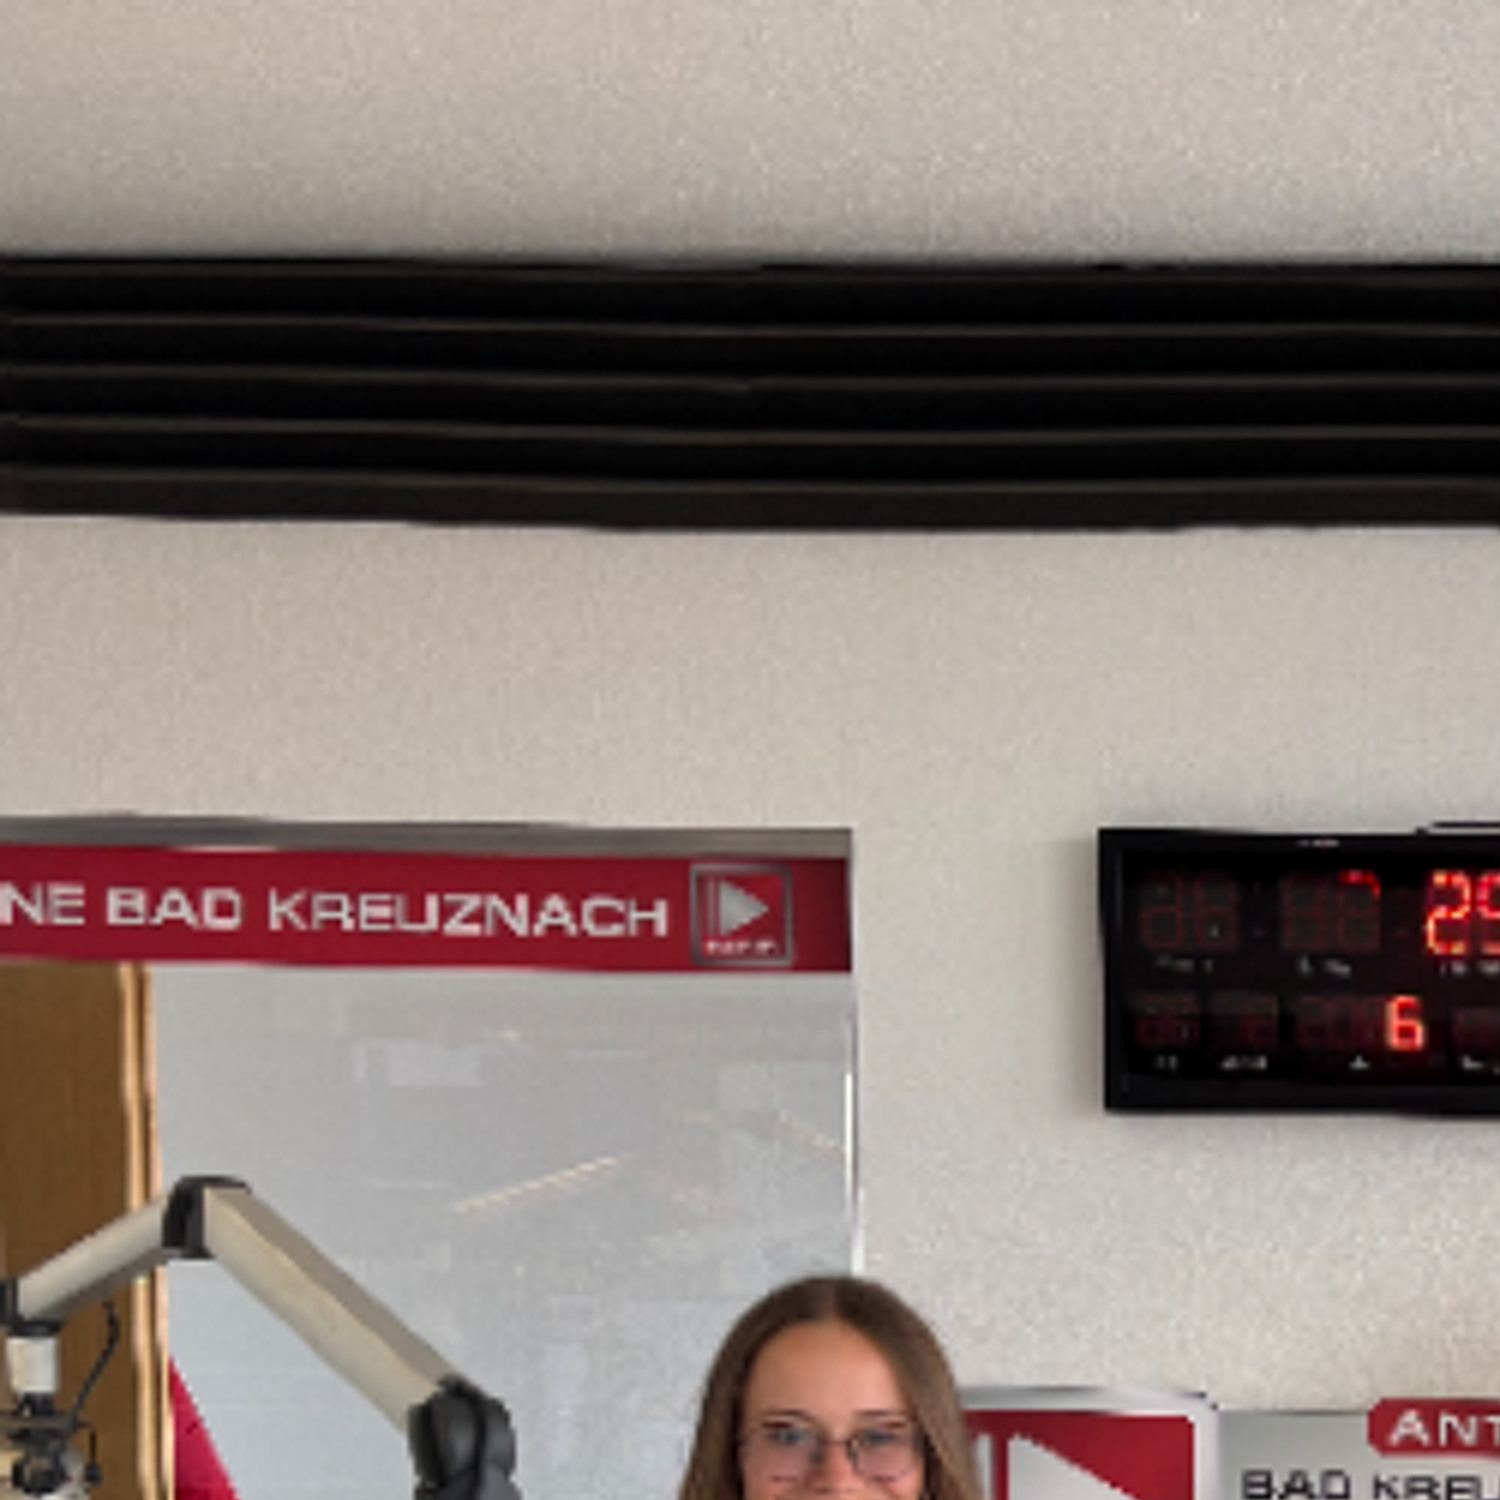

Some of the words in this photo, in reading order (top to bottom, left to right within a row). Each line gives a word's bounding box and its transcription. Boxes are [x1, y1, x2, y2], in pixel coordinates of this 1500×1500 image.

[106, 887, 243, 931] BAD
[267, 888, 669, 937] KREUZNACH
[1386, 995, 1425, 1051] 6
[1241, 1469, 1352, 1500] BAD
